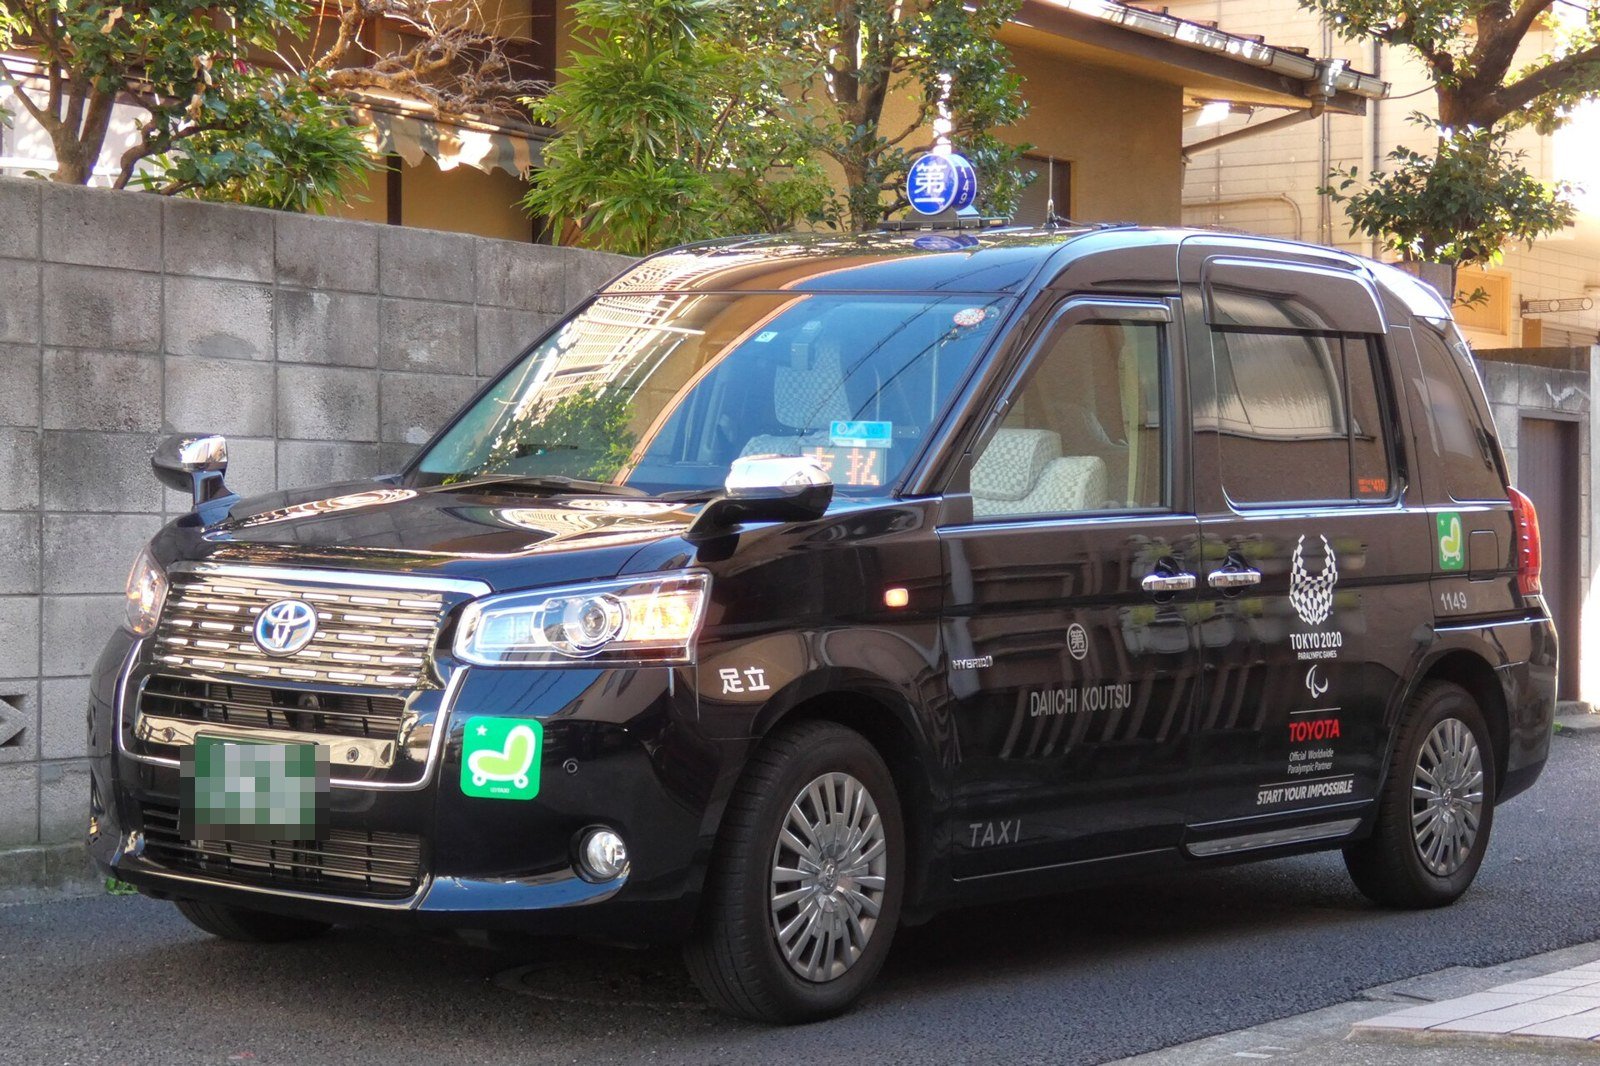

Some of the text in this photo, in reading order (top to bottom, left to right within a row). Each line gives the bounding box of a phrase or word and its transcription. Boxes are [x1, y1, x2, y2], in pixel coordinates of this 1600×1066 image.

[914, 162, 947, 203] 第一
[1440, 592, 1467, 611] 1149
[1289, 631, 1343, 650] TOKYO 2020
[952, 657, 987, 670] HYBRID
[719, 666, 770, 695] 足立
[1030, 684, 1132, 717] DAIICHI KOUTSU
[1289, 720, 1340, 742] TOYOTA
[1288, 748, 1334, 762] Official Worldwide
[1287, 761, 1333, 775] Paralympic Partner
[1256, 780, 1353, 805] START YOUR IMPOSSIBLE
[969, 819, 1021, 848] TAXI
